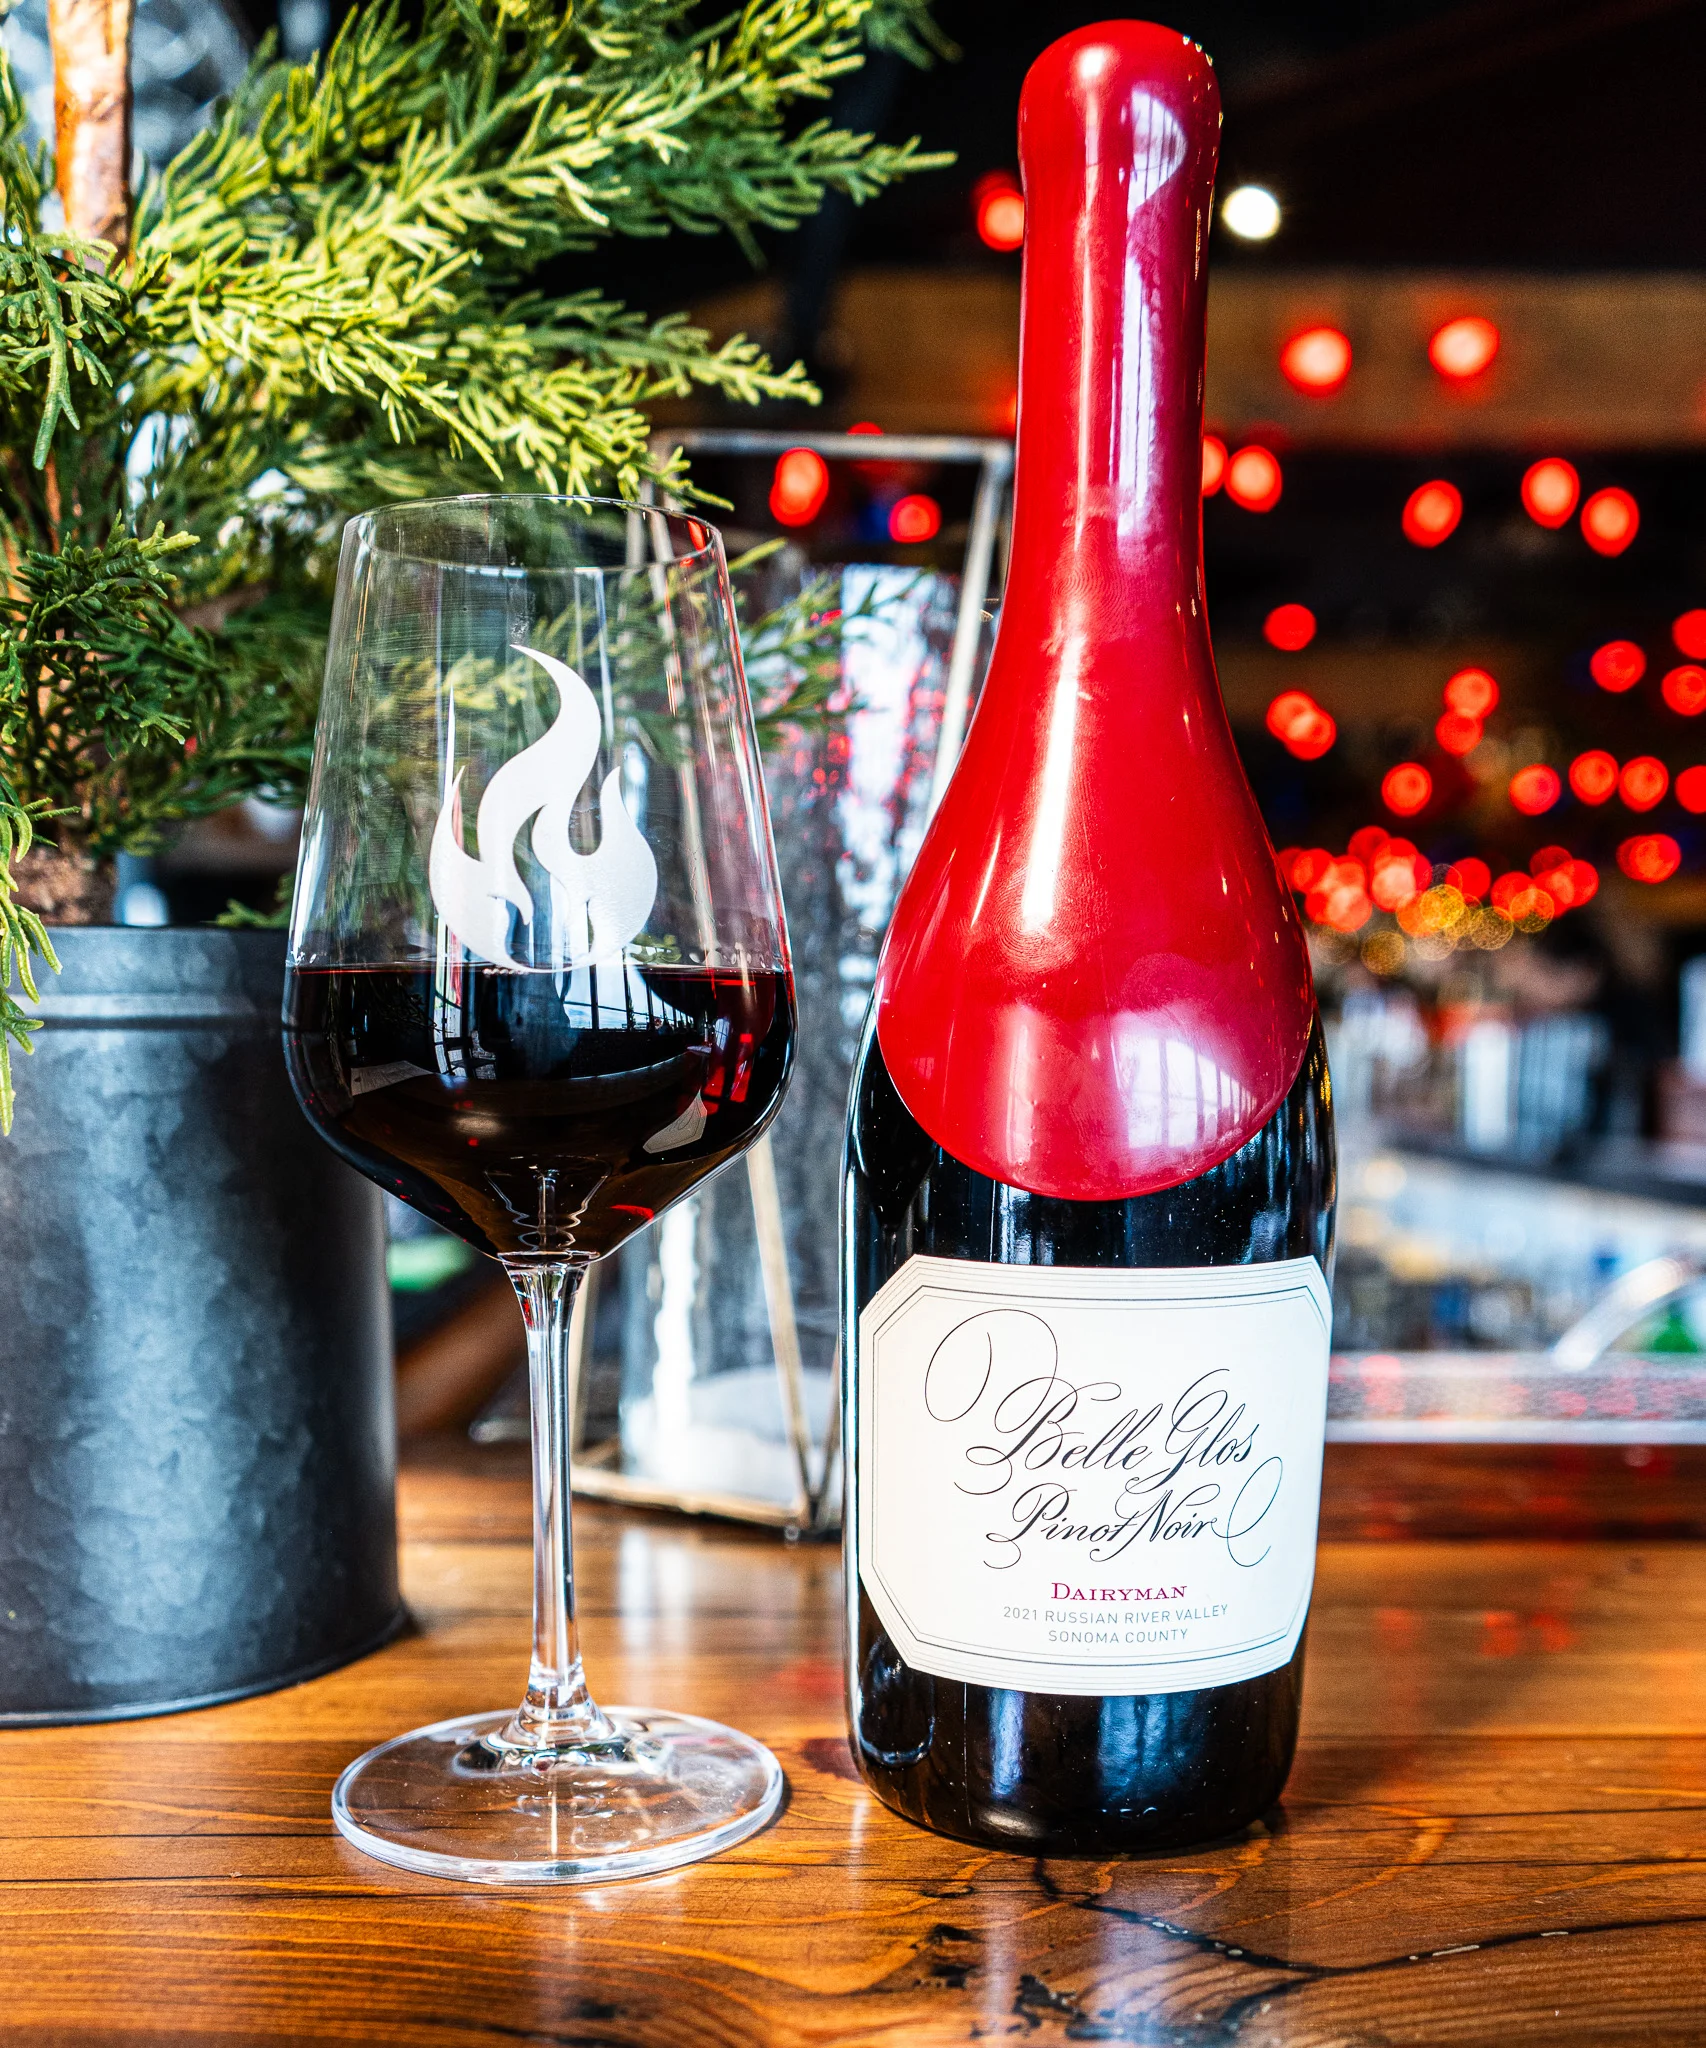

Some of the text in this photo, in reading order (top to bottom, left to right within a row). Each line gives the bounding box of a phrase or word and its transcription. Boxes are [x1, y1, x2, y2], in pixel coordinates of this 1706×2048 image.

[925, 1308, 1260, 1496] Belle Glos
[983, 1482, 1139, 1570] Pinot
[1051, 1582, 1188, 1601] DAIRYMAN
[1003, 1603, 1229, 1624] 2021 RUSSIAN RIVER VALLEY
[1048, 1628, 1189, 1644] SONOMA COUNTY
